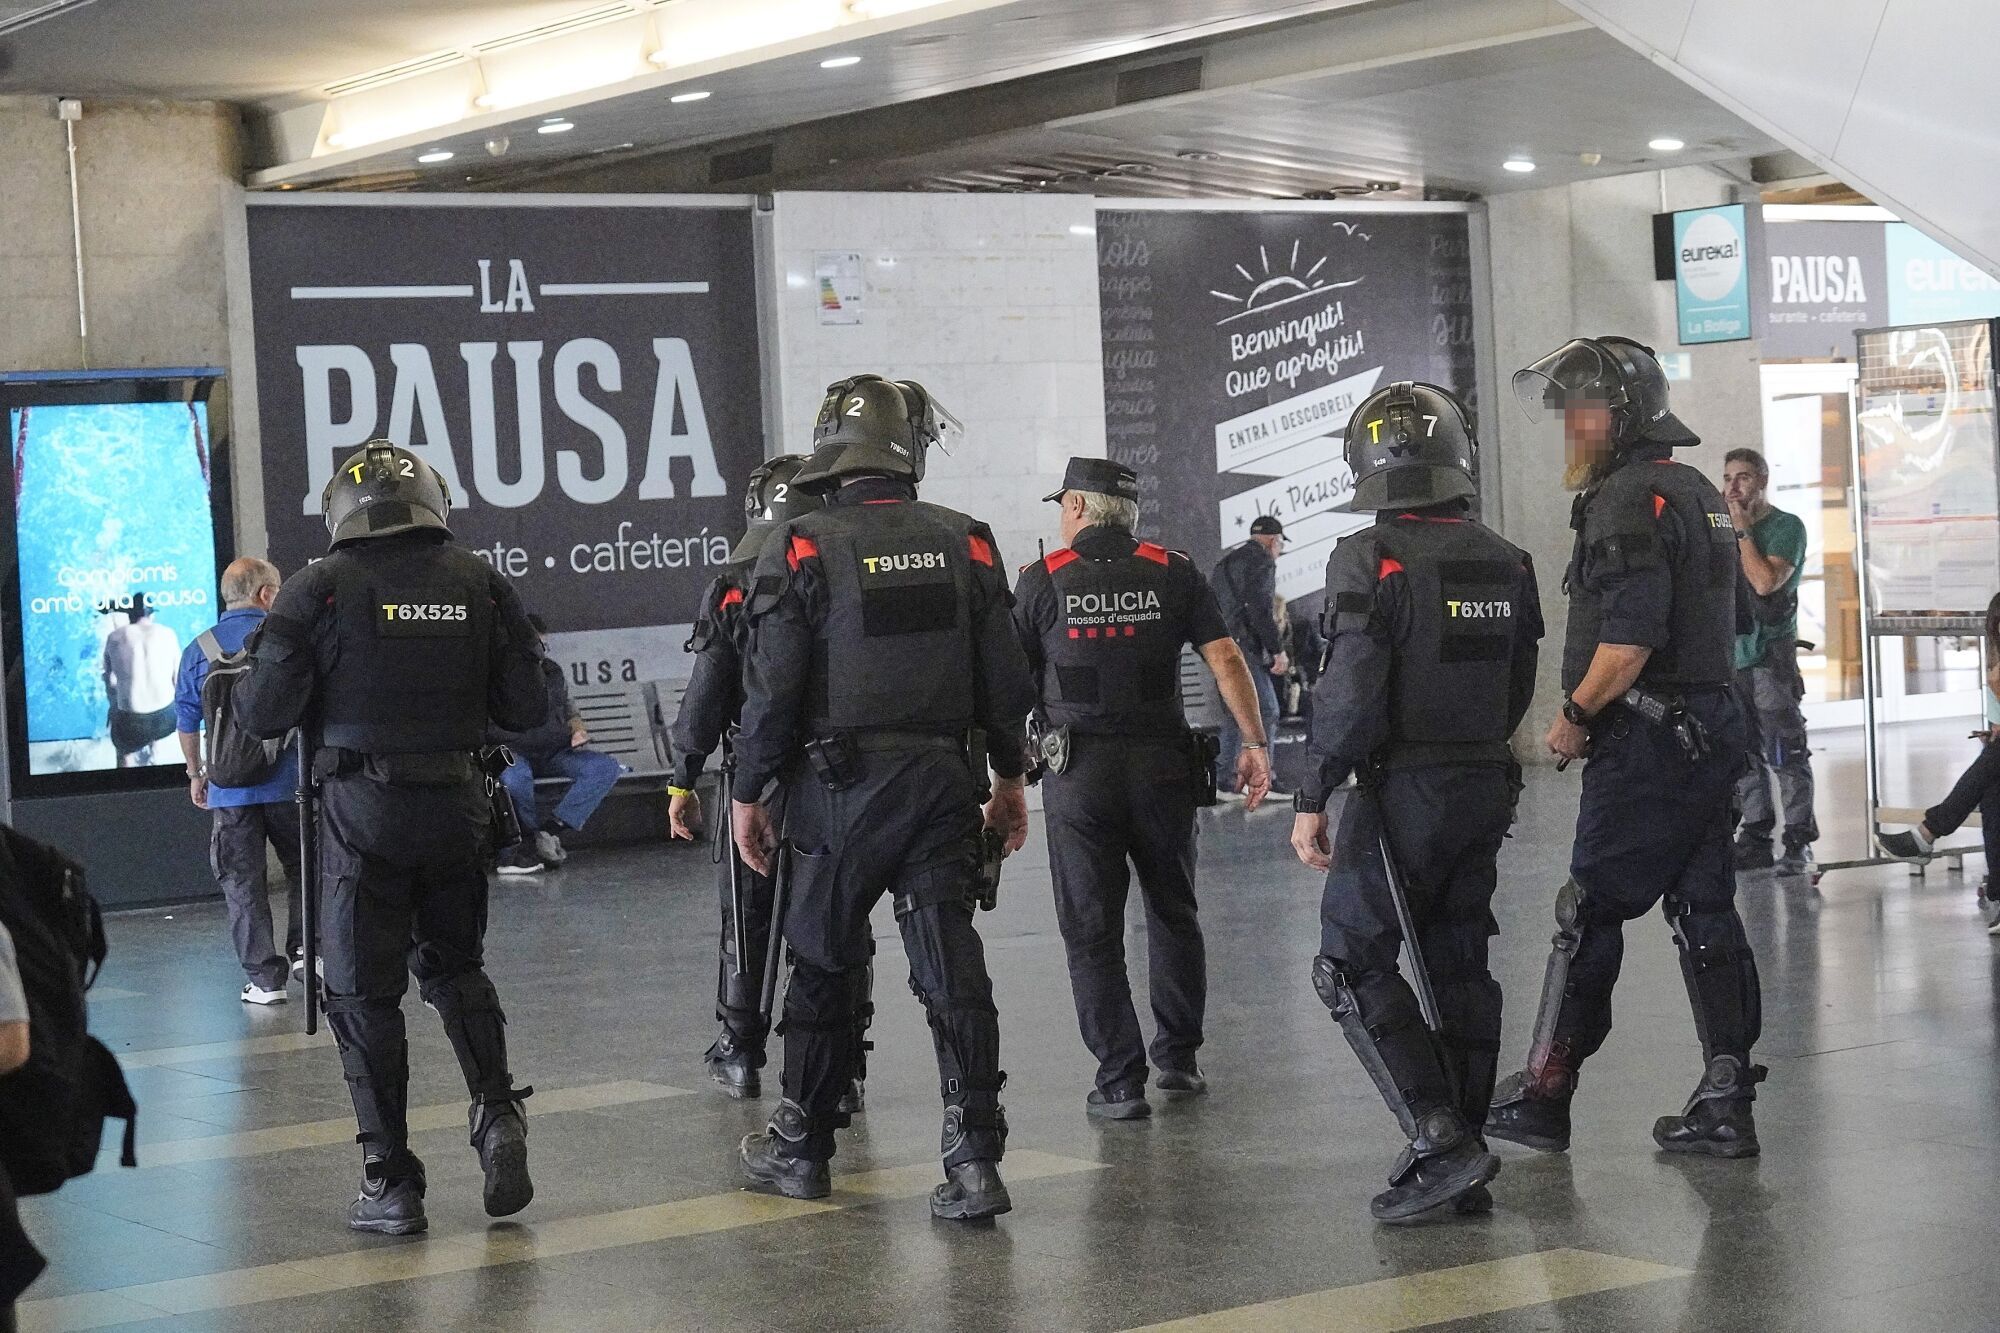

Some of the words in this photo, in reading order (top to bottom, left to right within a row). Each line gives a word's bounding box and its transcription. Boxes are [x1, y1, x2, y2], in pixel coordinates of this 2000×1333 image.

[1681, 238, 1739, 263] eureka!
[477, 258, 535, 313] LA
[1770, 255, 1867, 304] PAUSA
[1230, 301, 1345, 362] Benvingut!
[1225, 366, 1271, 397] Que
[1275, 330, 1365, 389] aprofiti!
[845, 396, 865, 417] 2
[296, 337, 727, 516] PAUSA
[1228, 419, 1270, 449] ENTRA
[1273, 419, 1279, 434] I
[1281, 392, 1355, 430] DESCOBREIX
[1367, 419, 1384, 444] T
[1422, 414, 1438, 437] 7
[348, 462, 365, 485] T
[399, 458, 415, 478] 2
[773, 483, 788, 503] 2
[570, 521, 731, 573] cafetería
[863, 552, 946, 574] T9U381
[30, 593, 83, 614] amb
[93, 594, 134, 611] una
[142, 588, 207, 608] causa
[382, 604, 467, 621] T6X525
[1065, 590, 1161, 614] POLICIA
[1447, 600, 1511, 618] T6X178
[1067, 615, 1106, 625] mossos
[1108, 610, 1161, 623] d'esquadra
[571, 658, 637, 686] usa
